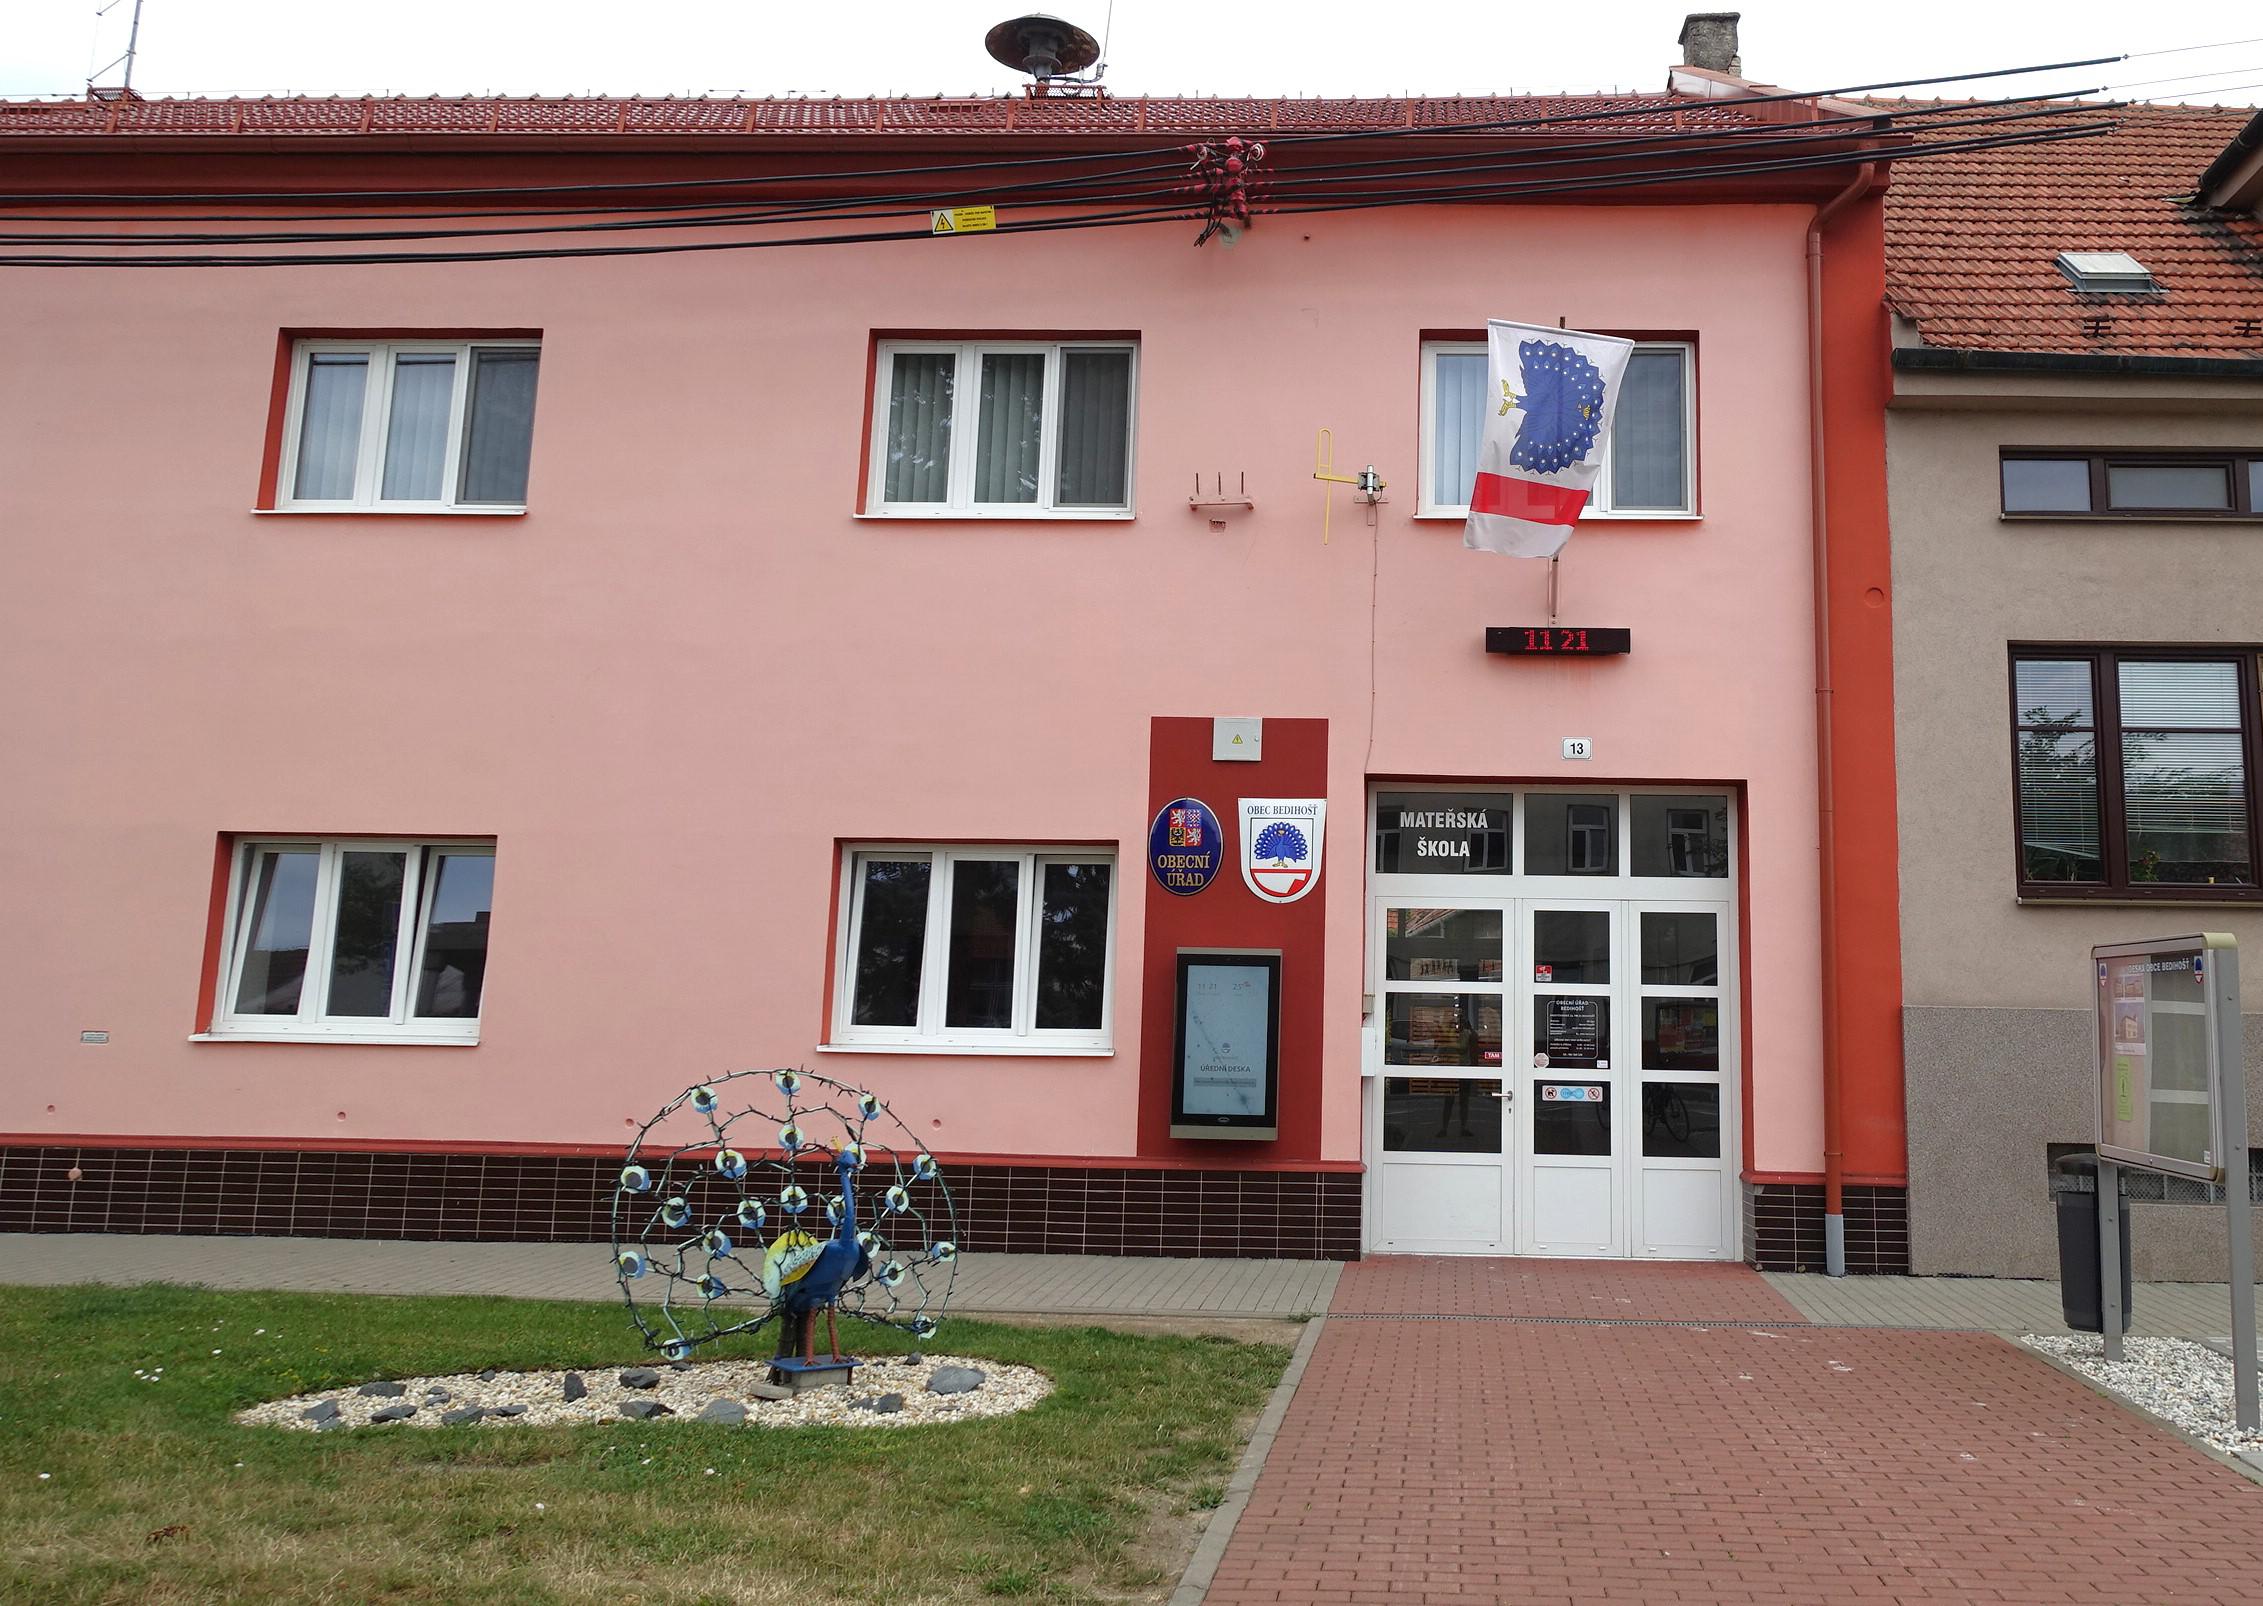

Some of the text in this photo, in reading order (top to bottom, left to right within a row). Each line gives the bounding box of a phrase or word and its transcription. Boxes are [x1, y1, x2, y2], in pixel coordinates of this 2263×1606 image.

[1524, 629, 1590, 651] 11 21
[1570, 742, 1584, 755] 13
[1247, 803, 1319, 816] OBEC BEDIHOŠŤ
[1399, 807, 1489, 829] MATEŘSKÁ
[1417, 836, 1470, 857] ŠKOLA
[1157, 851, 1211, 869] OBECNÍ
[1167, 869, 1205, 887] ÚŘAD
[2146, 962, 2161, 972] OBCE
[2162, 957, 2190, 971] BEDIHOŠŤ
[1200, 1064, 1251, 1073] ÚŘEDNÍ DESKA
